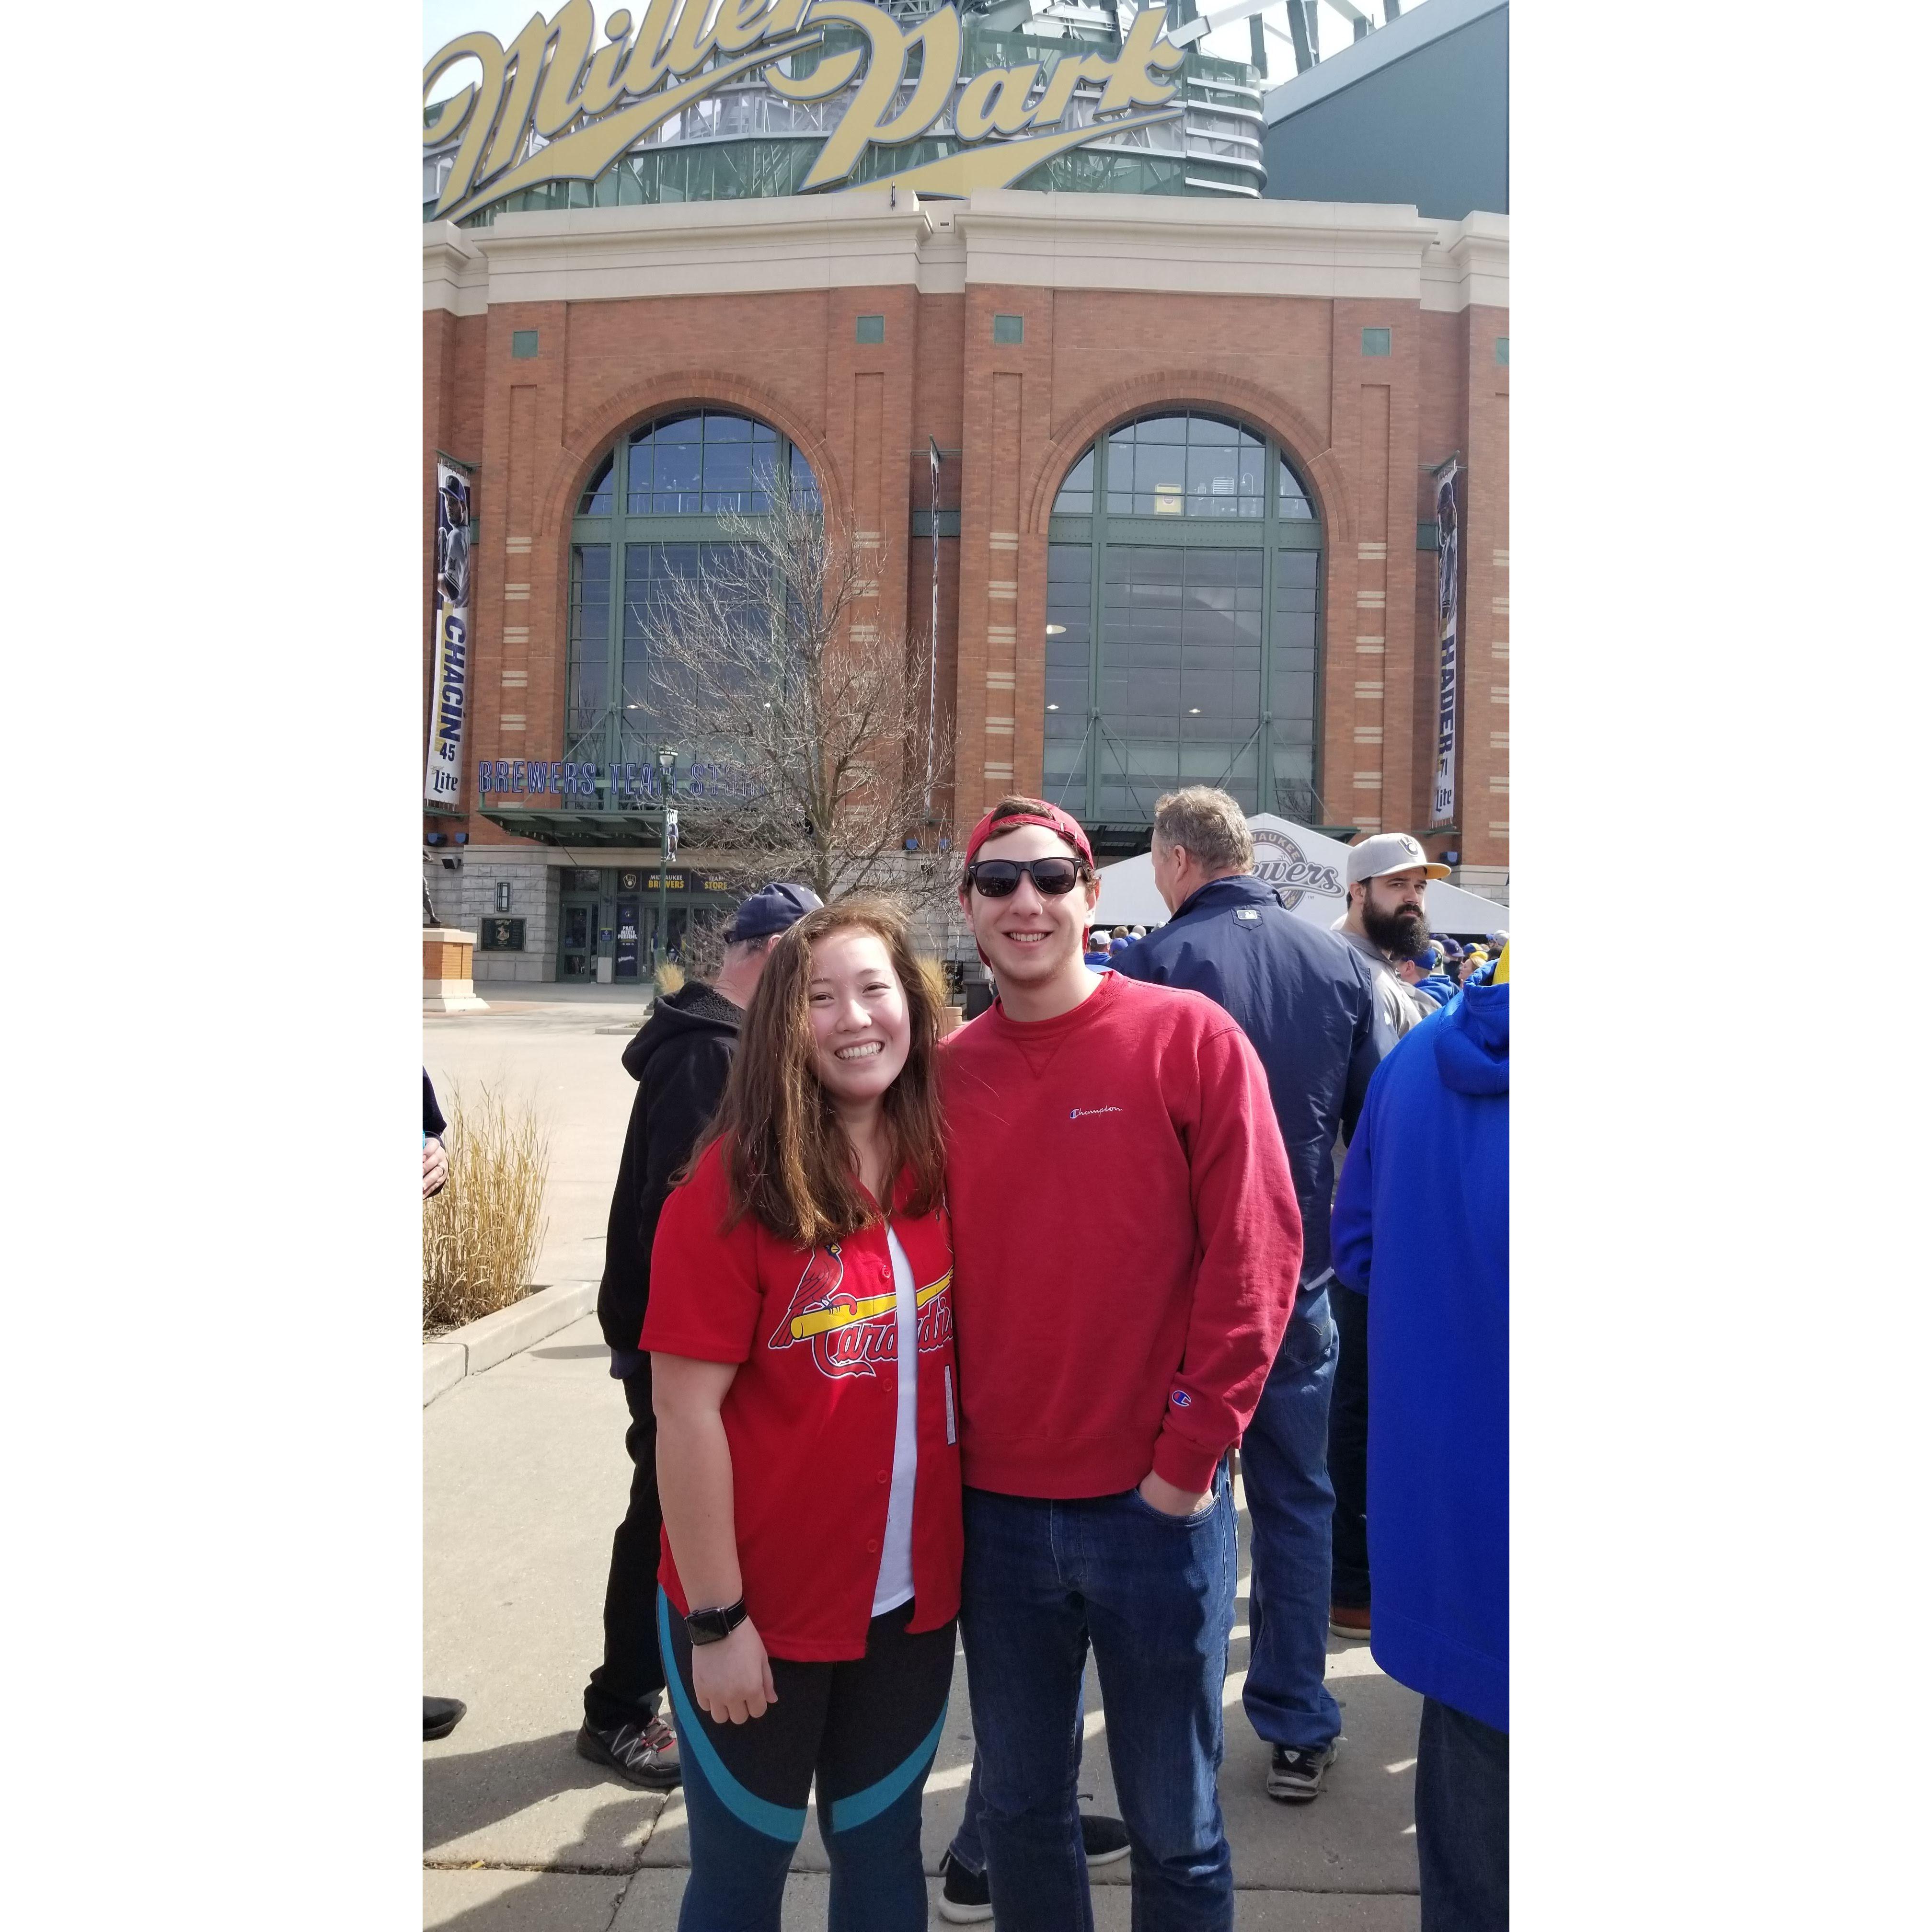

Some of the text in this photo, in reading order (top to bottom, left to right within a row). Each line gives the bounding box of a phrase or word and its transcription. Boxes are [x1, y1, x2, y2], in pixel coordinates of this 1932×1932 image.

[766, 0, 1186, 193] Park
[1438, 634, 1455, 755] HADER
[439, 742, 455, 761] 45
[479, 761, 595, 794] BREWERS
[1440, 758, 1447, 777] 71
[433, 769, 458, 794] Lite
[1436, 788, 1451, 812] Lite
[704, 881, 727, 889] STORE
[1070, 1105, 1123, 1119] Champion
